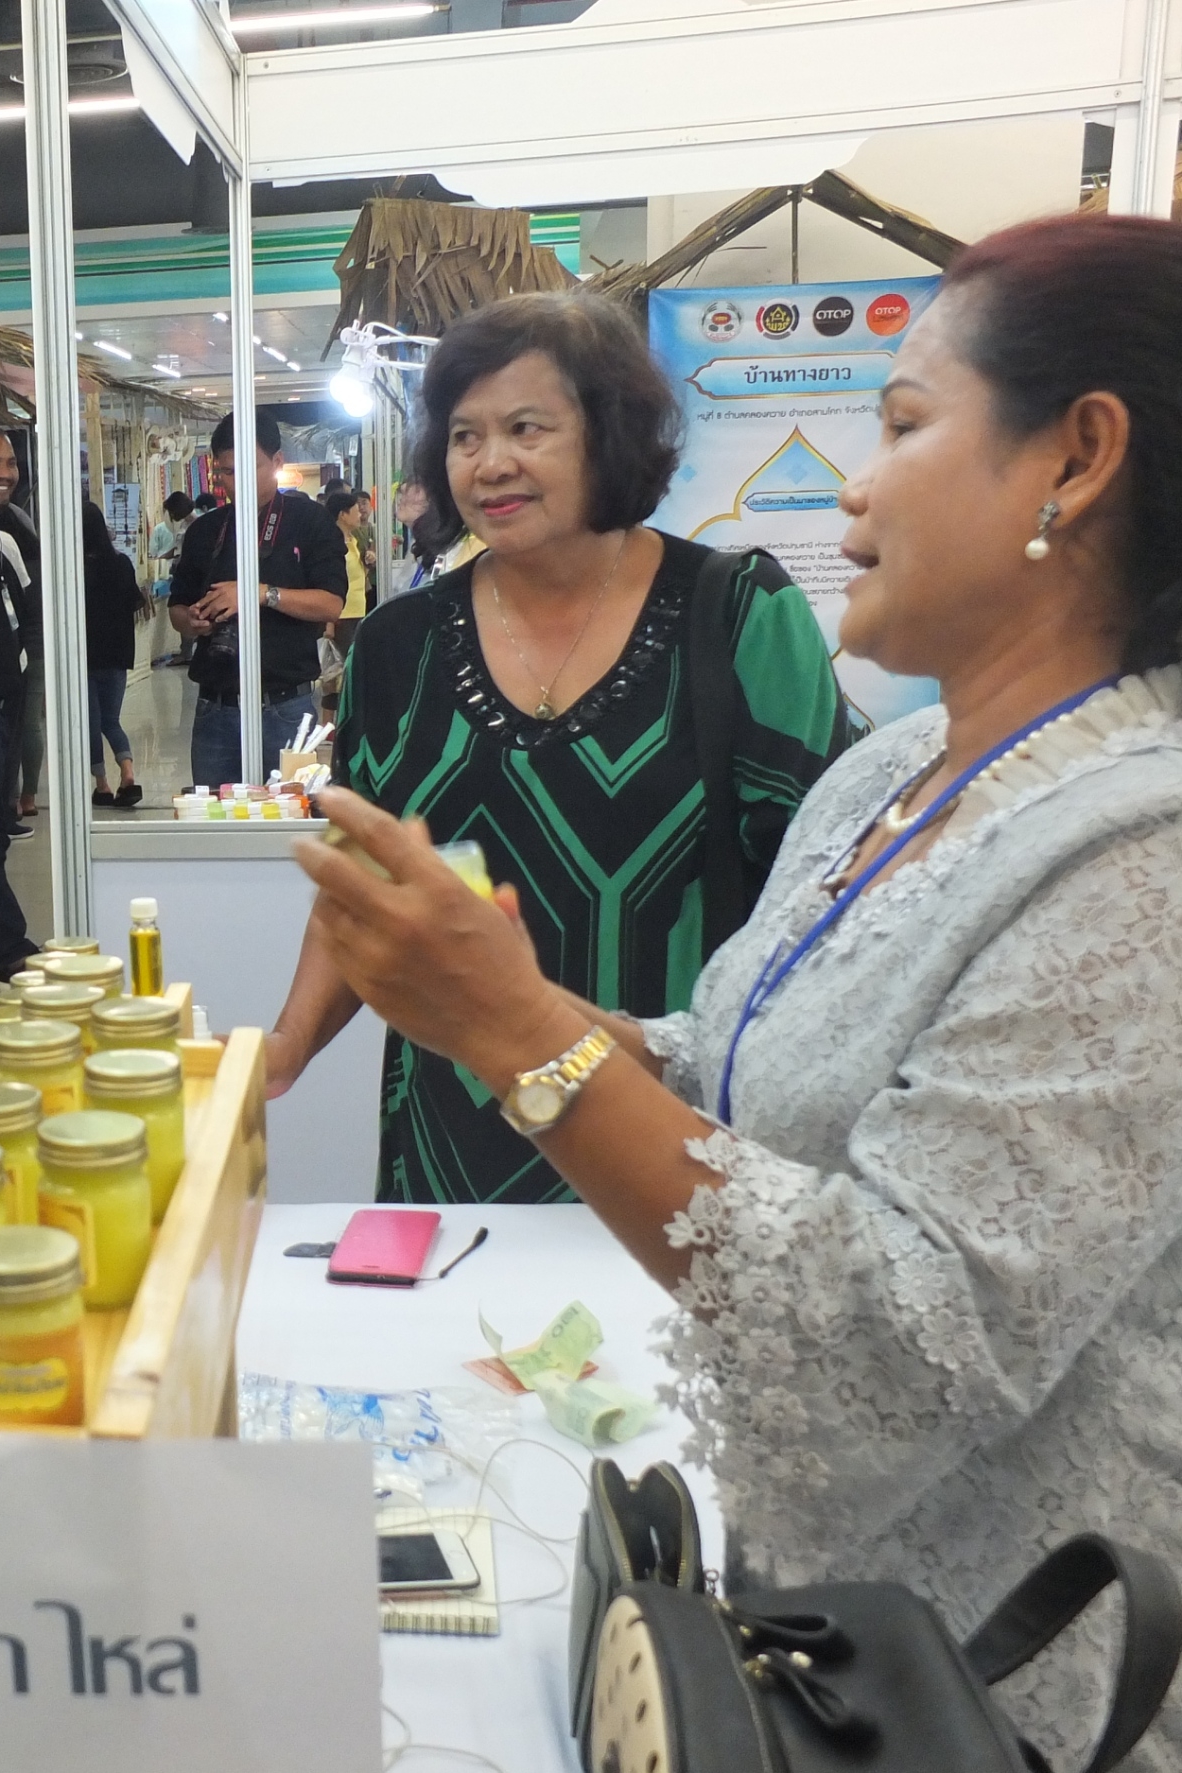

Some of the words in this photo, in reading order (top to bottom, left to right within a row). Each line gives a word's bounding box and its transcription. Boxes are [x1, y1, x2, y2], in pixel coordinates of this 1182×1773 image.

[815, 309, 851, 320] OTOP
[874, 306, 901, 315] OTOP
[744, 365, 852, 385] บ้านทางยาว
[33, 1599, 200, 1696] ไหล่
